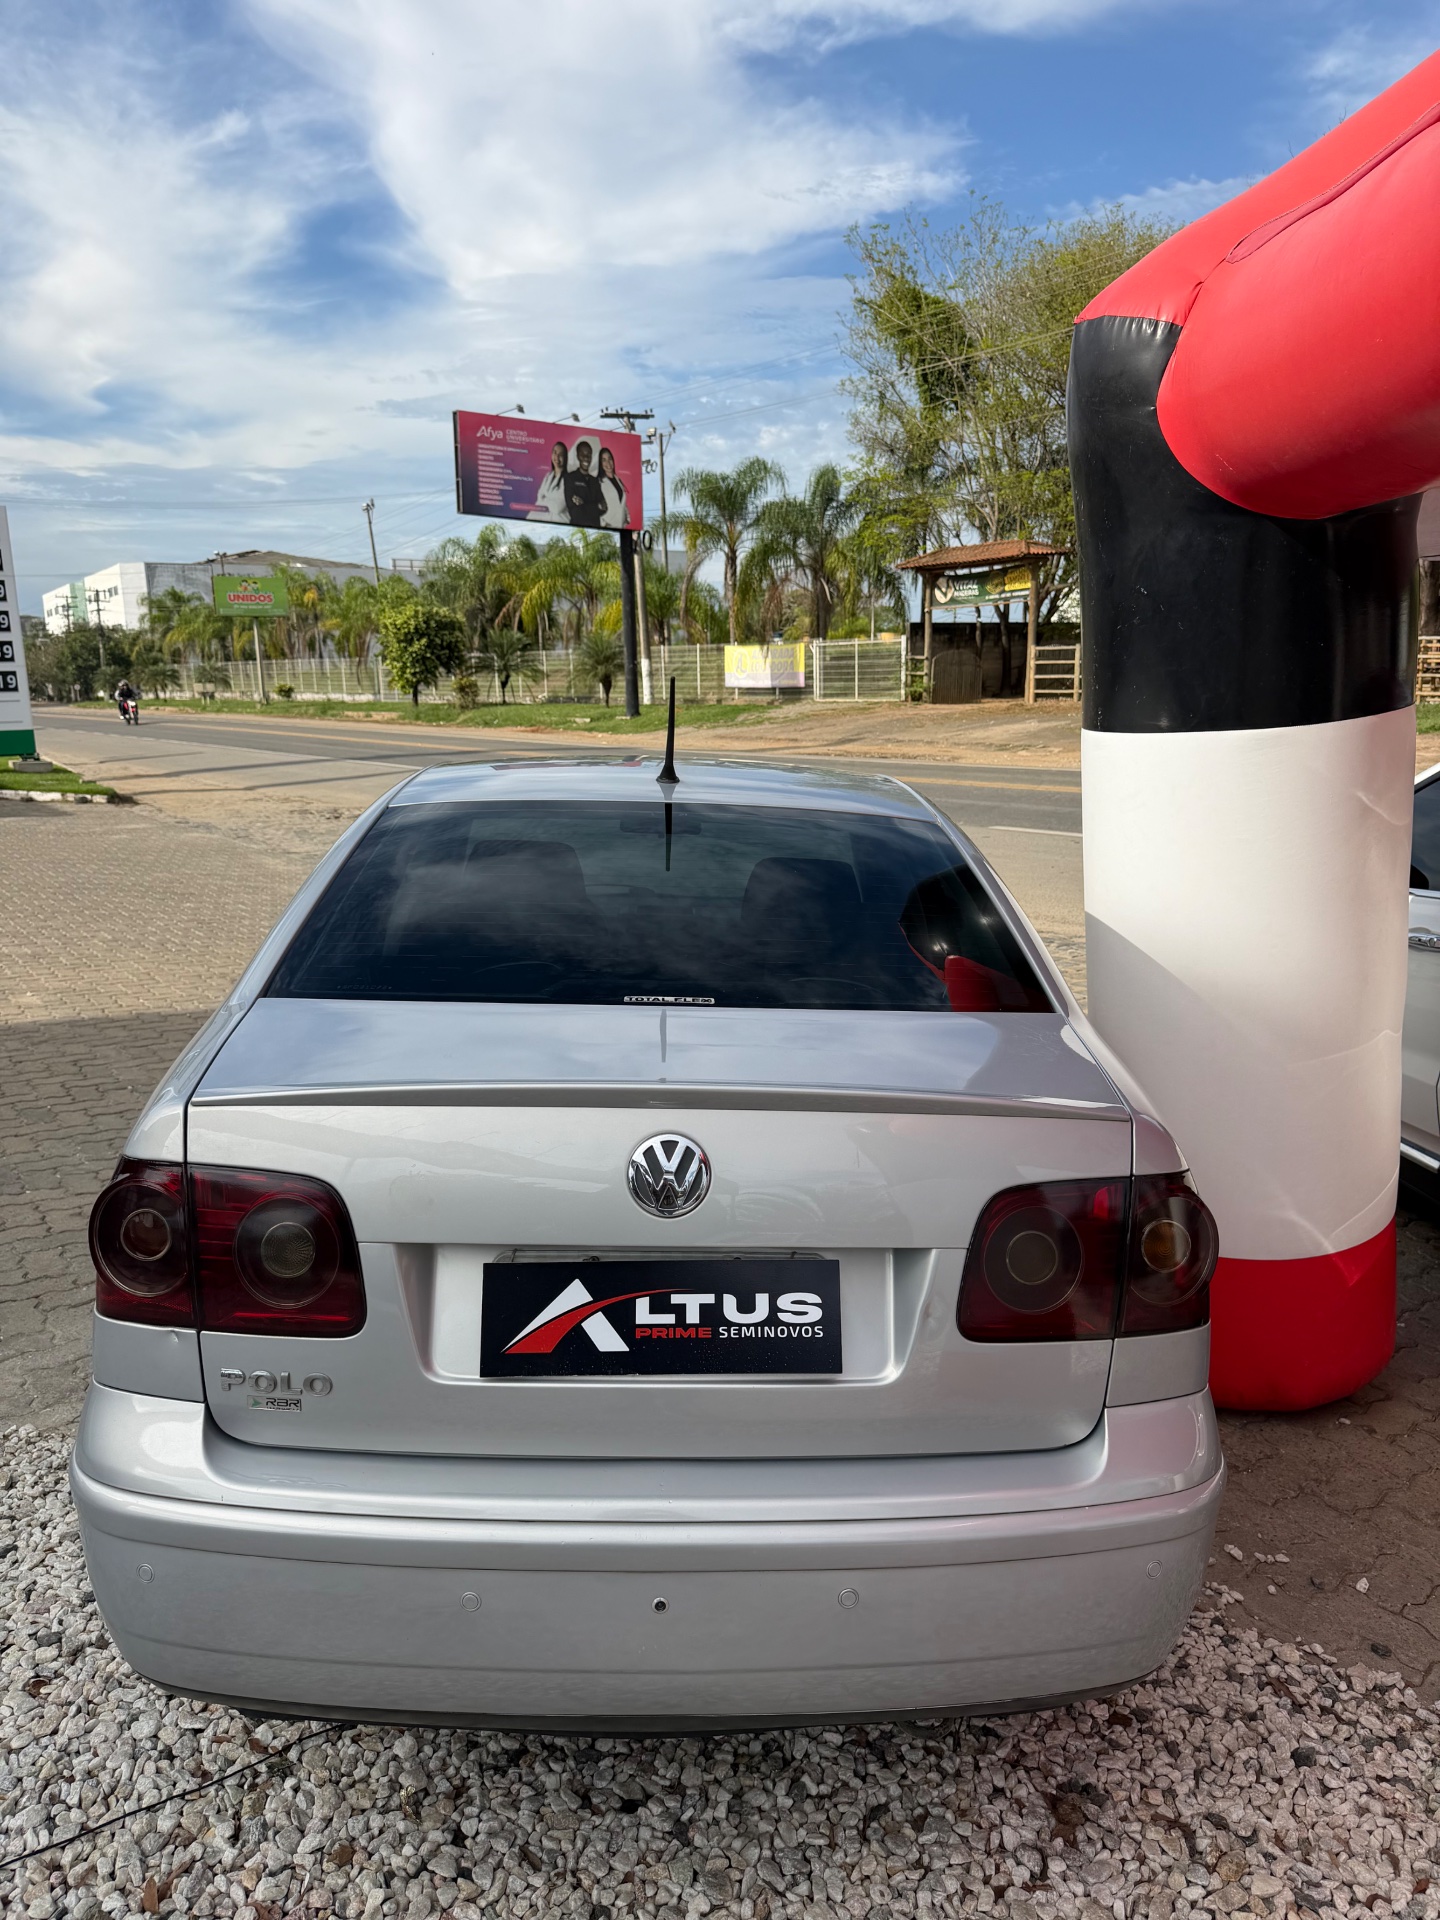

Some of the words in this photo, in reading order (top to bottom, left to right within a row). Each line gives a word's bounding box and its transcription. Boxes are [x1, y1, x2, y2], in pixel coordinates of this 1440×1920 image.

[476, 425, 503, 441] Afya
[954, 579, 978, 590] VITAL
[227, 593, 274, 603] UNIDOS
[501, 1278, 824, 1354] ALTUS
[635, 1327, 713, 1339] PRIME
[719, 1325, 824, 1339] SEMINOVOS
[220, 1367, 334, 1398] POLO
